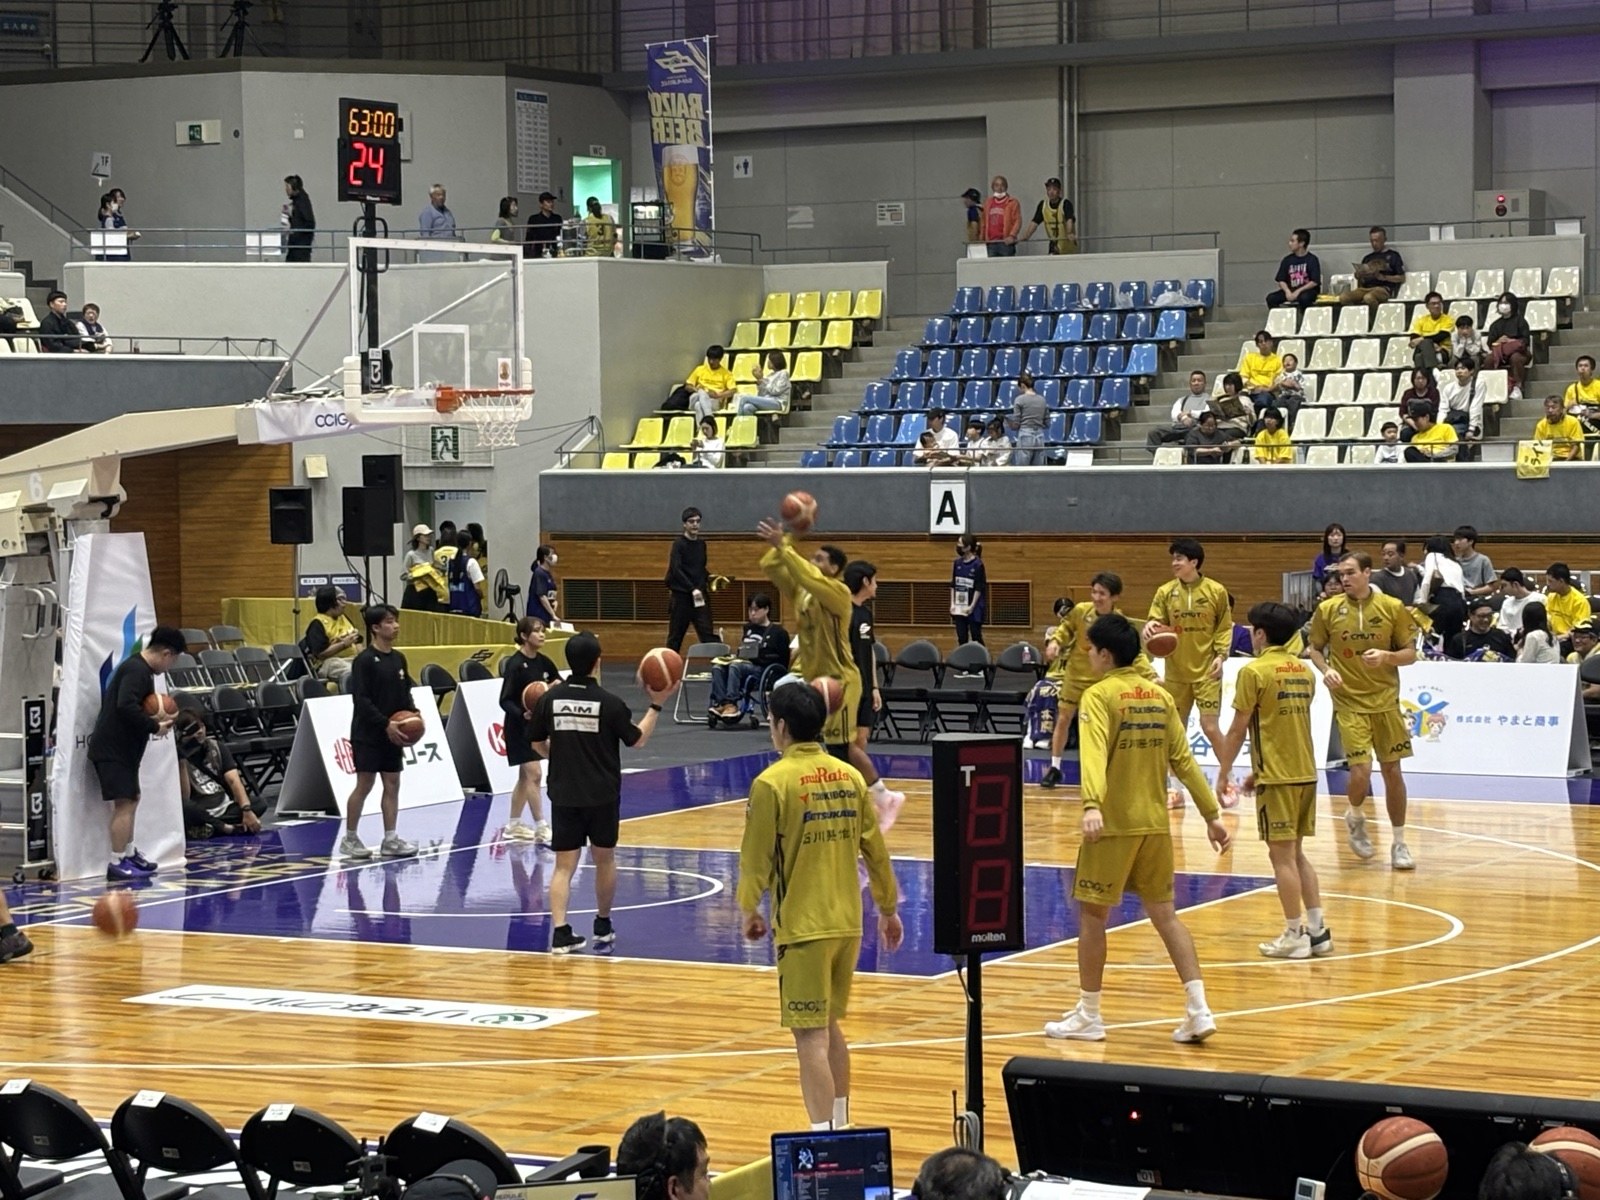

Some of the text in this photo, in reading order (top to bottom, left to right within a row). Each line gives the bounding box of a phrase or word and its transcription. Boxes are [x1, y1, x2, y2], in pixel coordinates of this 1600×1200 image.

[348, 108, 395, 138] 63:00
[349, 142, 384, 185] 24
[30, 472, 44, 501] 6
[936, 491, 960, 525] A
[561, 705, 592, 713] AIM
[1498, 715, 1560, 727] やまと商事
[960, 765, 976, 787] T
[971, 932, 1006, 943] molten
